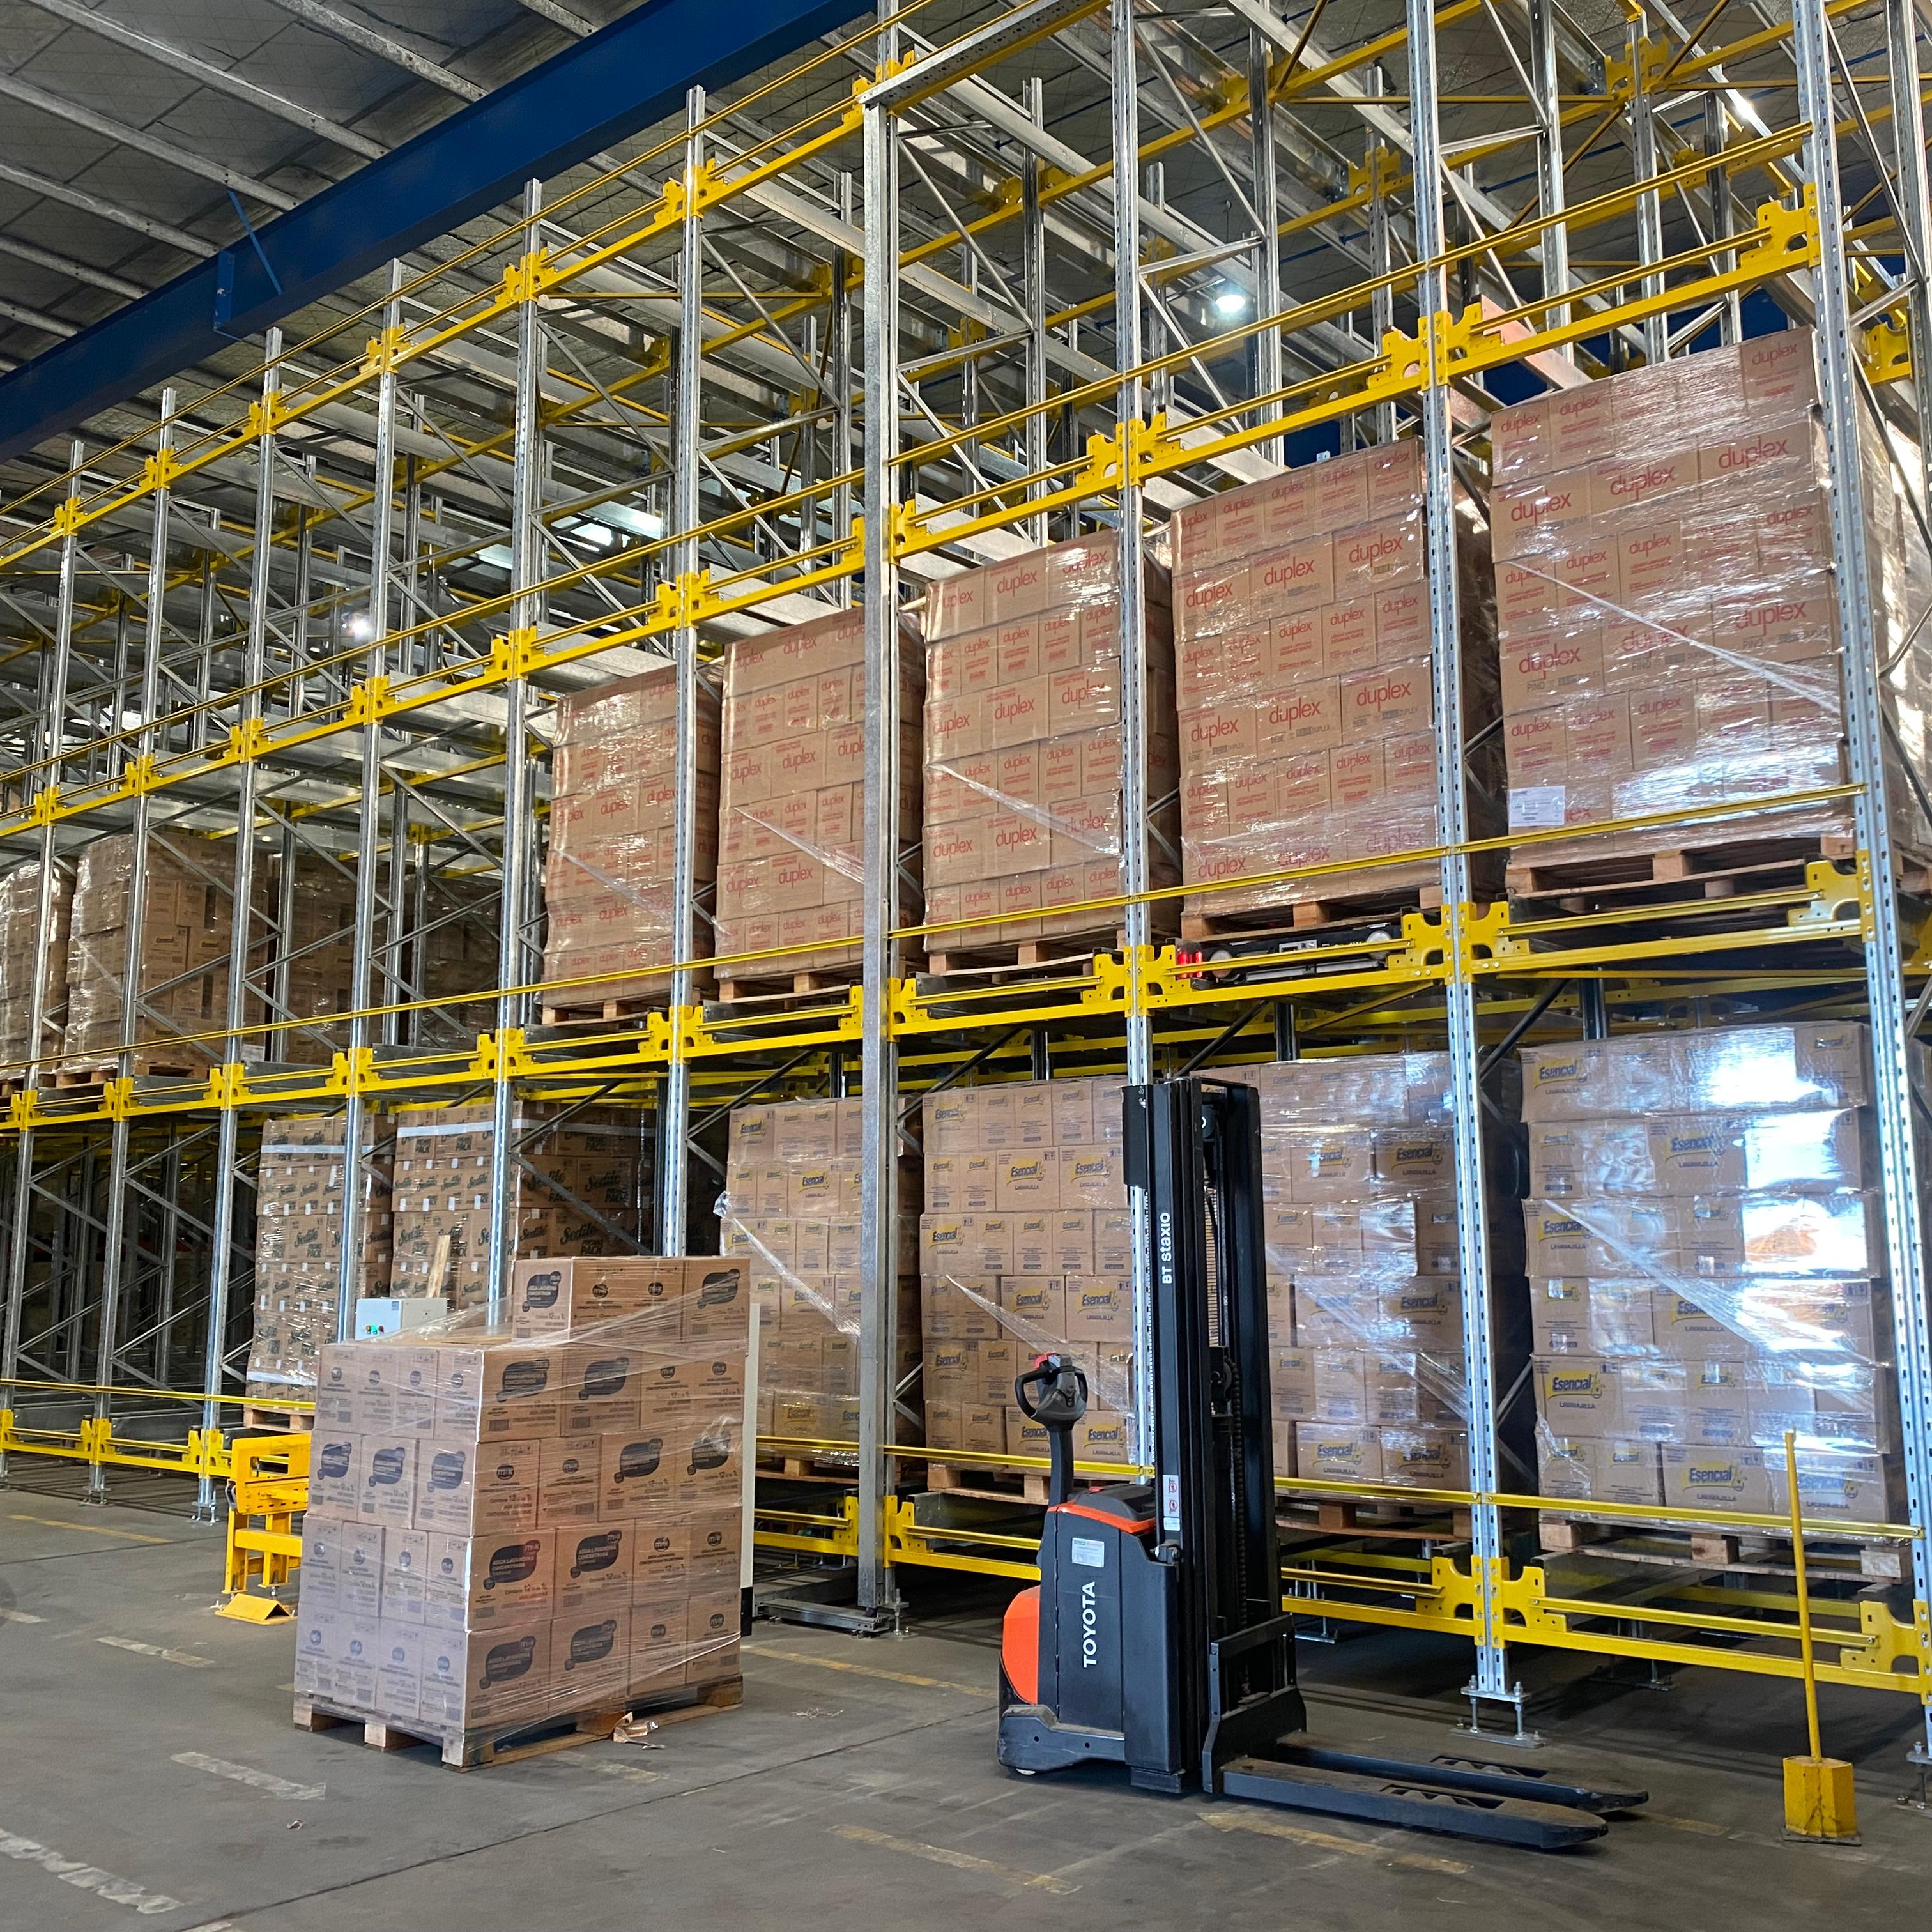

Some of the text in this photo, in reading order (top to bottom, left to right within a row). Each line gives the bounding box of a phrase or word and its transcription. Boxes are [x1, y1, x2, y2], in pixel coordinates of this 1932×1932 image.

[1752, 342, 1798, 368] duplex
[1560, 396, 1600, 418] duplex
[1501, 413, 1540, 435] duplex
[1374, 451, 1411, 471] duplex
[1719, 436, 1789, 468] duplex
[1321, 464, 1356, 485] duplex
[1610, 466, 1675, 501] duplex
[1271, 479, 1304, 501] duplex
[1223, 494, 1256, 516] duplex
[1510, 489, 1572, 526] duplex
[1766, 505, 1813, 526] duplex
[1349, 534, 1404, 568] duplex
[1629, 534, 1672, 558] duplex
[1566, 549, 1607, 572] duplex
[997, 567, 1038, 597] duplex
[1264, 556, 1315, 589] duplex
[1505, 565, 1544, 586] duplex
[1186, 582, 1233, 611] duplex
[1383, 594, 1419, 615] duplex
[1044, 615, 1071, 634] duplex
[1087, 606, 1114, 624] duplex
[1330, 607, 1365, 628] duplex
[1735, 601, 1807, 636] duplex
[838, 617, 865, 645] duple
[1003, 626, 1030, 645] duplex
[1279, 618, 1313, 640] duplex
[783, 633, 817, 659] duplex
[964, 638, 990, 656] duplex
[1183, 645, 1214, 665] duplex
[1518, 643, 1582, 680] duplex
[788, 686, 810, 702] duplex
[1062, 678, 1106, 710] duplex
[1356, 678, 1411, 712] duplex
[995, 694, 1036, 725] duplex
[1269, 696, 1321, 730] duplex
[1639, 697, 1682, 719] duplex
[933, 710, 970, 739] duplex
[1512, 717, 1552, 740] duplex
[1572, 709, 1615, 730] duplex
[1191, 715, 1238, 747] duplex
[838, 734, 865, 762] duple
[1046, 744, 1075, 763] duplex
[1088, 735, 1117, 755] duplex
[1394, 740, 1430, 763] duplex
[782, 747, 816, 773] duplex
[1004, 753, 1031, 772] duplex
[1336, 752, 1371, 773] duplex
[730, 759, 762, 785] duplex
[965, 762, 991, 781] duplex
[1286, 762, 1321, 780] duplex
[1187, 784, 1219, 801] duplex
[1234, 772, 1268, 792] duplex
[600, 800, 629, 819] duplex
[785, 801, 807, 816] duplex
[822, 794, 845, 808] duplex
[1064, 809, 1108, 838] duplex
[995, 822, 1037, 852] duplex
[1366, 826, 1421, 855] duplex
[933, 835, 973, 862] duplex
[778, 862, 813, 889] duplex
[1089, 864, 1117, 886] duplex
[1197, 856, 1246, 881] duplex
[726, 875, 759, 898] duplex
[1005, 881, 1032, 901] duplex
[1046, 873, 1075, 893] duplex
[965, 889, 991, 907] duplex
[599, 902, 628, 926] duplex
[783, 916, 806, 933] duplex
[817, 910, 841, 928] duplex
[1539, 1059, 1578, 1080] Esencial
[740, 1120, 762, 1135] Esencial
[1396, 1142, 1433, 1162] Esencial
[1671, 1133, 1715, 1152] Esencial
[1010, 1162, 1038, 1178] Esencial
[1075, 1158, 1105, 1176] Esencial
[802, 1172, 825, 1188] Esencial
[932, 1226, 958, 1243] Esencial
[1543, 1220, 1583, 1234] Esencial
[581, 1245, 602, 1255] PACK
[1162, 1266, 1173, 1284] BT
[1016, 1289, 1043, 1305] Esencial
[1082, 1289, 1112, 1305] Esencial
[1400, 1291, 1438, 1308] Esencial
[935, 1351, 962, 1367] Esencial
[1552, 1374, 1592, 1392] Esencial
[1088, 1426, 1119, 1443] Esencial
[1317, 1441, 1353, 1457] Esencial
[1688, 1464, 1733, 1483] Esencial
[1082, 1581, 1097, 1669] TOYOTA
